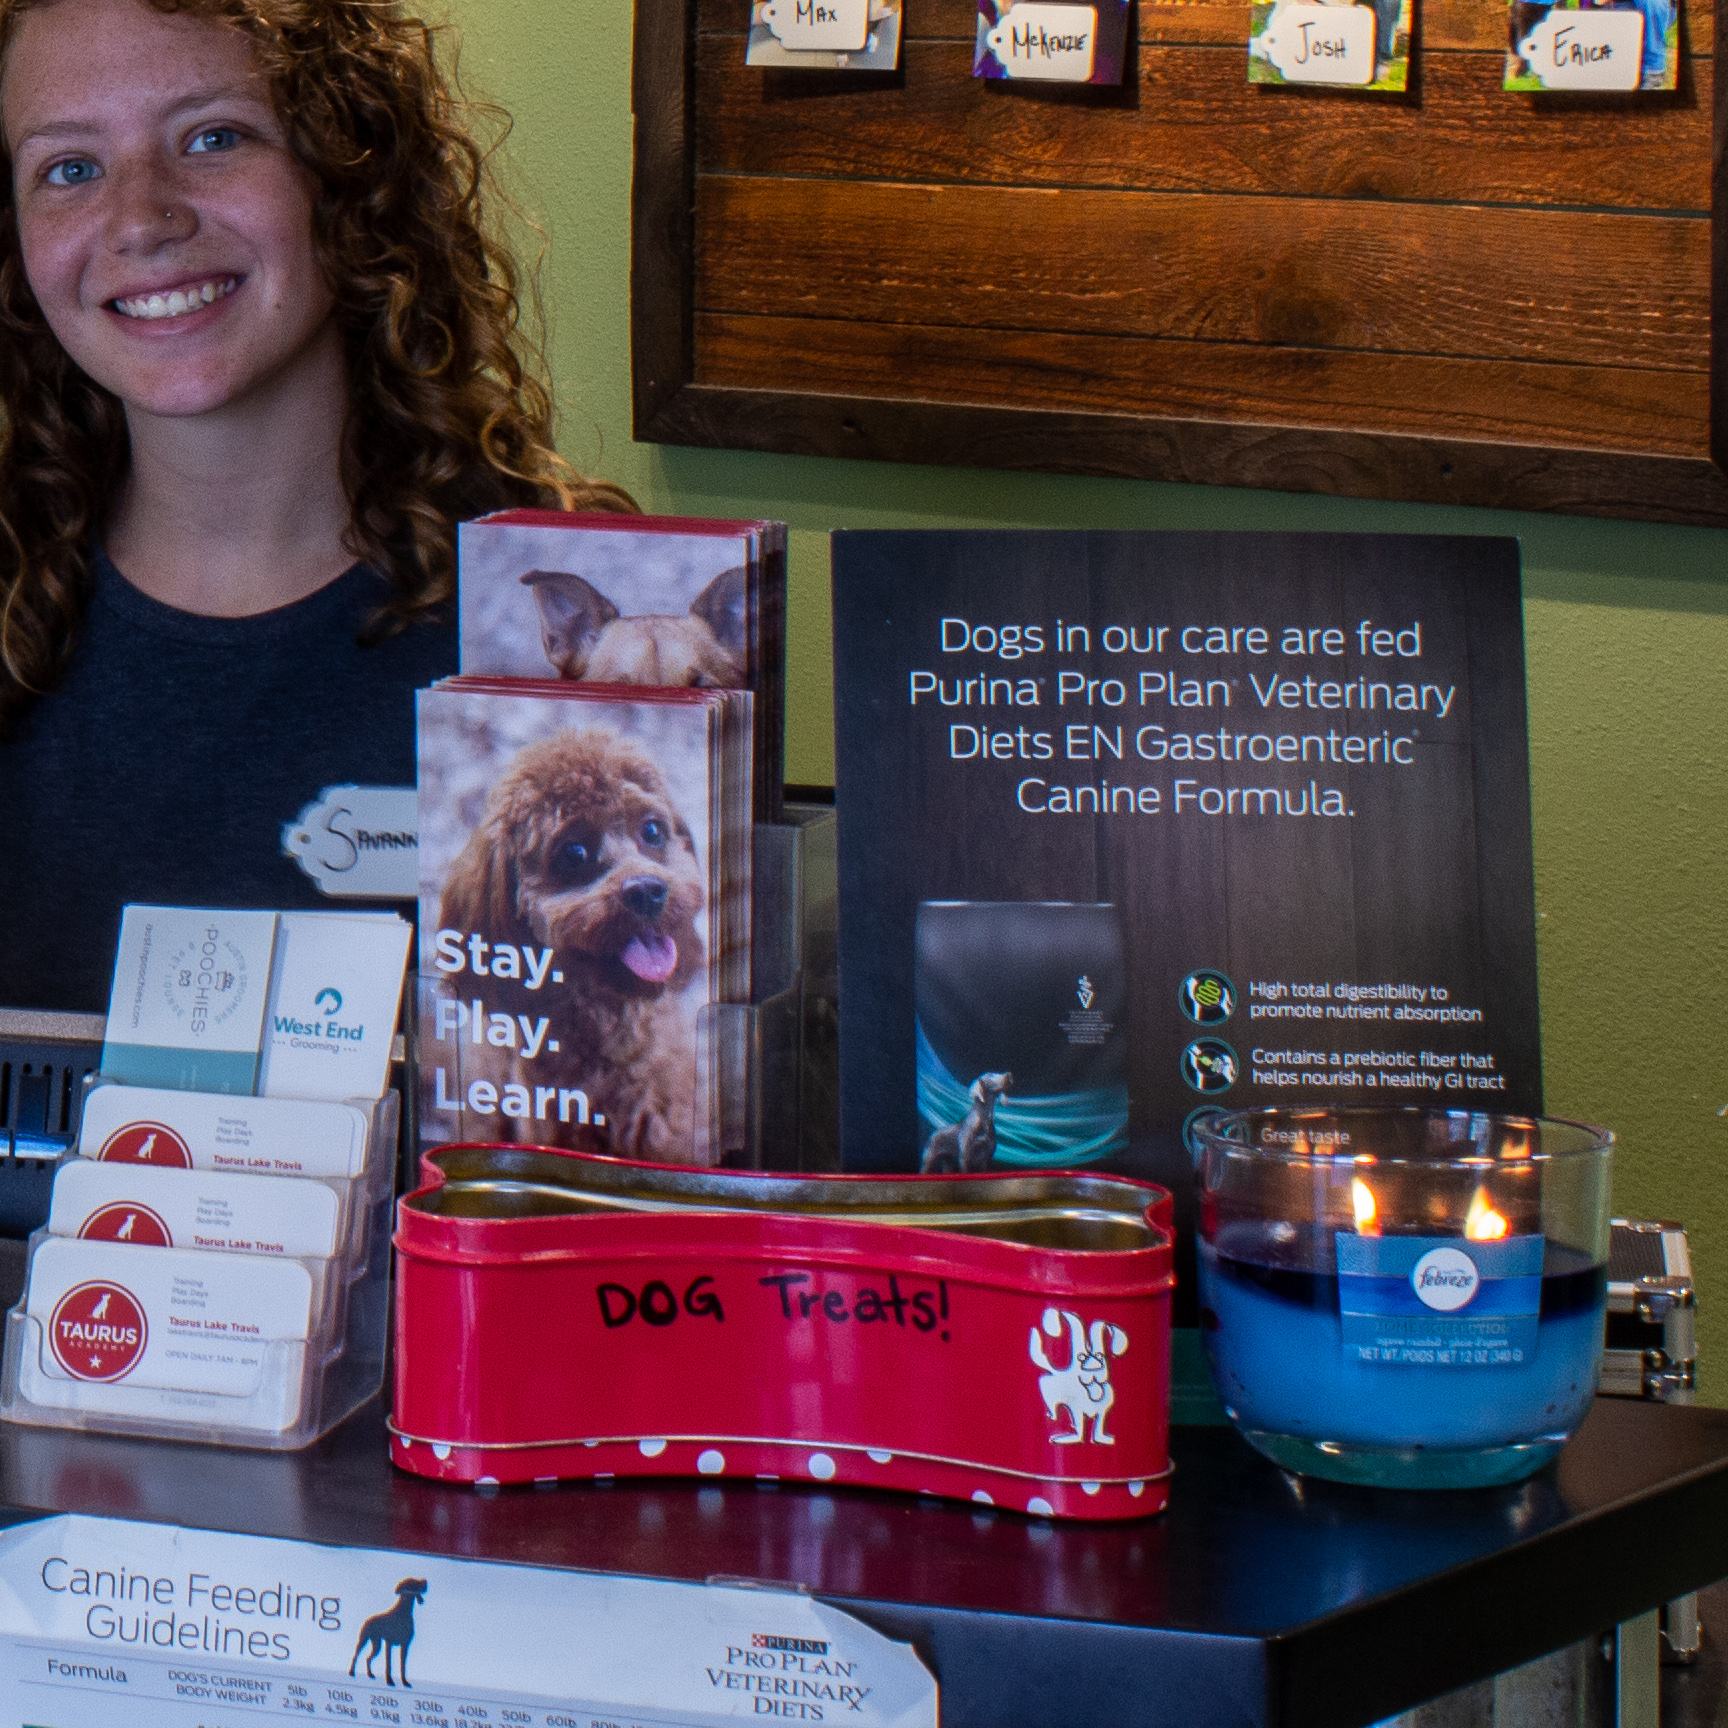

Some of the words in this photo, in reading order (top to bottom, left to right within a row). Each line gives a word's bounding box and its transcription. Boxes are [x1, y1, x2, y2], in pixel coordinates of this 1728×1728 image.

[941, 619, 1044, 659] Dogs
[1057, 619, 1090, 653] in
[1103, 625, 1170, 653] our
[1181, 626, 1268, 654] care
[1281, 627, 1345, 655] are
[1356, 621, 1422, 657] fed
[1058, 671, 1126, 707] Pro
[1248, 673, 1456, 718] Veterinary
[949, 725, 1053, 761] Diets
[1066, 725, 1123, 760] EN
[1017, 779, 1161, 814] Canine
[1174, 779, 1356, 817] Formula.
[434, 928, 564, 990] Stay.
[190, 928, 219, 1033] POOCHIES
[1249, 981, 1288, 1000] High
[1291, 983, 1331, 999] total
[1334, 983, 1427, 1003] digestibility
[1430, 985, 1449, 1001] to
[1250, 1004, 1323, 1020] promote
[1326, 1004, 1390, 1020] nutrient
[1394, 1005, 1483, 1023] absorption
[273, 1015, 321, 1038] West
[326, 1022, 364, 1041] End
[435, 998, 560, 1059] Play.
[290, 1038, 340, 1053] Grooming
[1251, 1048, 1326, 1065] Contains
[1329, 1053, 1341, 1066] a
[1344, 1050, 1417, 1068] prebiotic
[1419, 1051, 1457, 1068] fiber
[1459, 1053, 1495, 1069] that
[1252, 1069, 1299, 1086] helps
[1302, 1069, 1363, 1087] nourish
[1366, 1074, 1377, 1087] a
[1380, 1071, 1442, 1090] healthy
[1444, 1073, 1462, 1089] GI
[1465, 1073, 1506, 1090] tract
[435, 1067, 606, 1126] Learn.
[1261, 1127, 1305, 1144] Great
[1309, 1129, 1350, 1145] taste
[213, 1154, 244, 1167] Taurus
[248, 1157, 271, 1168] Lake
[274, 1159, 302, 1171] Travis
[194, 1235, 226, 1248] Taurus
[228, 1238, 252, 1250] Lake
[254, 1241, 284, 1253] Travis
[1419, 1266, 1474, 1289] febreze
[596, 1275, 724, 1329] DOG
[758, 1273, 951, 1343] Treats!
[60, 1321, 138, 1345] TAURUS
[168, 1315, 201, 1328] Taurus
[204, 1319, 227, 1331] Lake
[231, 1322, 260, 1334] Travis
[68, 1341, 126, 1352] ACADEMY
[41, 1557, 174, 1605] Canine
[188, 1574, 341, 1631] Feeding
[86, 1603, 290, 1660] Guidelines
[726, 1646, 775, 1668] PRO
[766, 1636, 827, 1655] PURINA
[47, 1658, 128, 1683] Formula
[168, 1670, 208, 1684] DOG'S
[210, 1674, 272, 1692] CURRENT
[327, 1689, 353, 1702] 10lb
[370, 1694, 399, 1708] 20lb
[414, 1699, 444, 1713] 30lb
[457, 1705, 487, 1718] 40lb
[501, 1709, 532, 1722] 50lb
[546, 1715, 577, 1728] 60lb
[176, 1684, 212, 1698] BODY
[216, 1688, 267, 1705] WEIGHT
[705, 1668, 871, 1712] VETERINARY
[753, 1695, 824, 1721] DIETS
